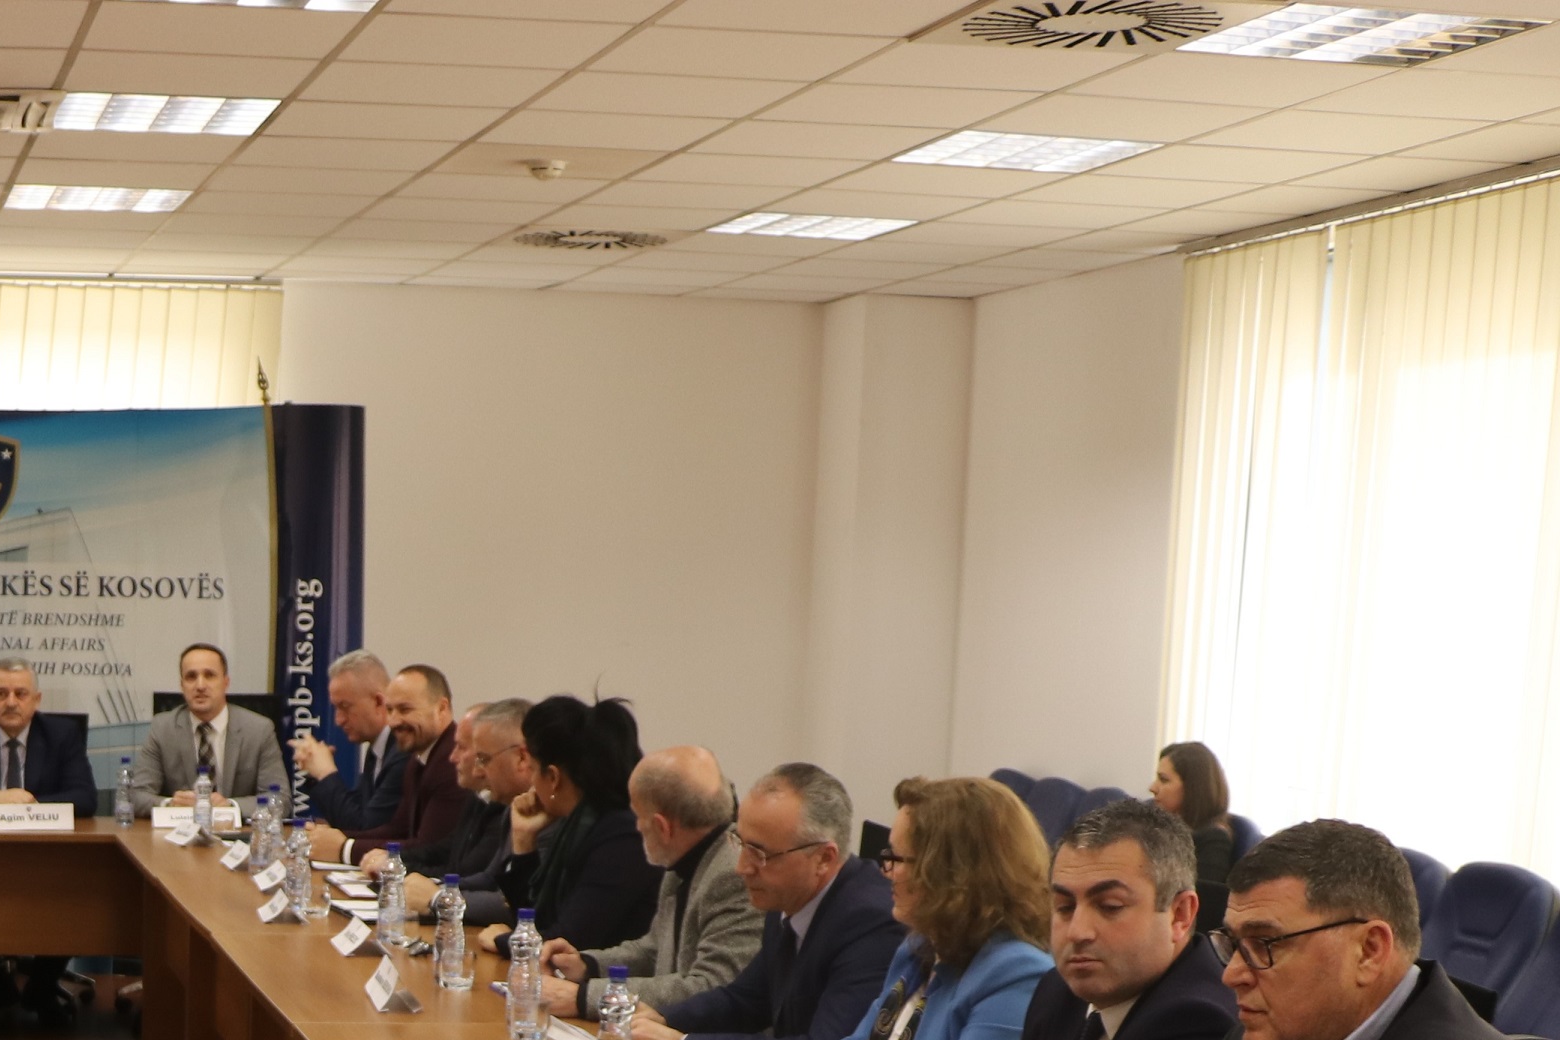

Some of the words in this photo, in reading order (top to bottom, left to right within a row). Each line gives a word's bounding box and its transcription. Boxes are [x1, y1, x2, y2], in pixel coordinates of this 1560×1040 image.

[59, 571, 90, 597] SË
[97, 573, 225, 599] KOSOVËS
[22, 612, 125, 627] BRENDSHME
[39, 637, 106, 651] AFFAIRS
[60, 662, 132, 677] POSLOVA
[0, 814, 25, 823] Agim
[28, 812, 60, 822] VELIU
